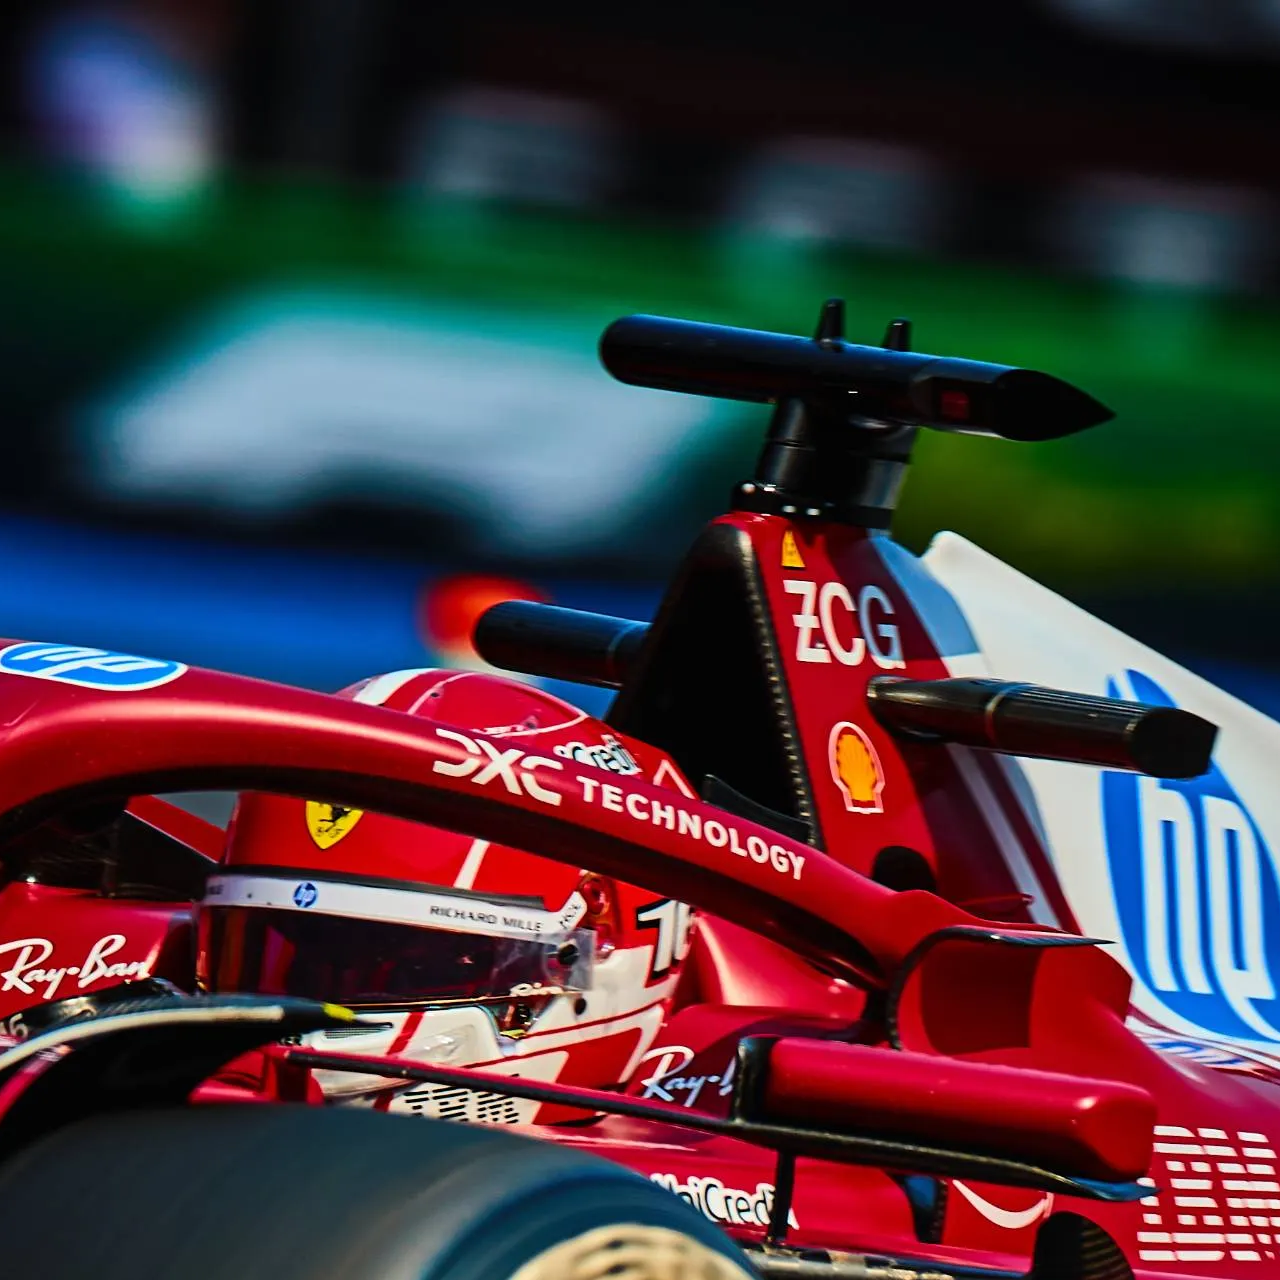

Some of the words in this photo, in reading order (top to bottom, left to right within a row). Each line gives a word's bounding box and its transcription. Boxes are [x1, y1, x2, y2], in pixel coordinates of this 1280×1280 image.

[576, 774, 807, 881] TECHNOLOGY
[430, 905, 498, 925] RICHARD
[503, 916, 542, 932] MILLE
